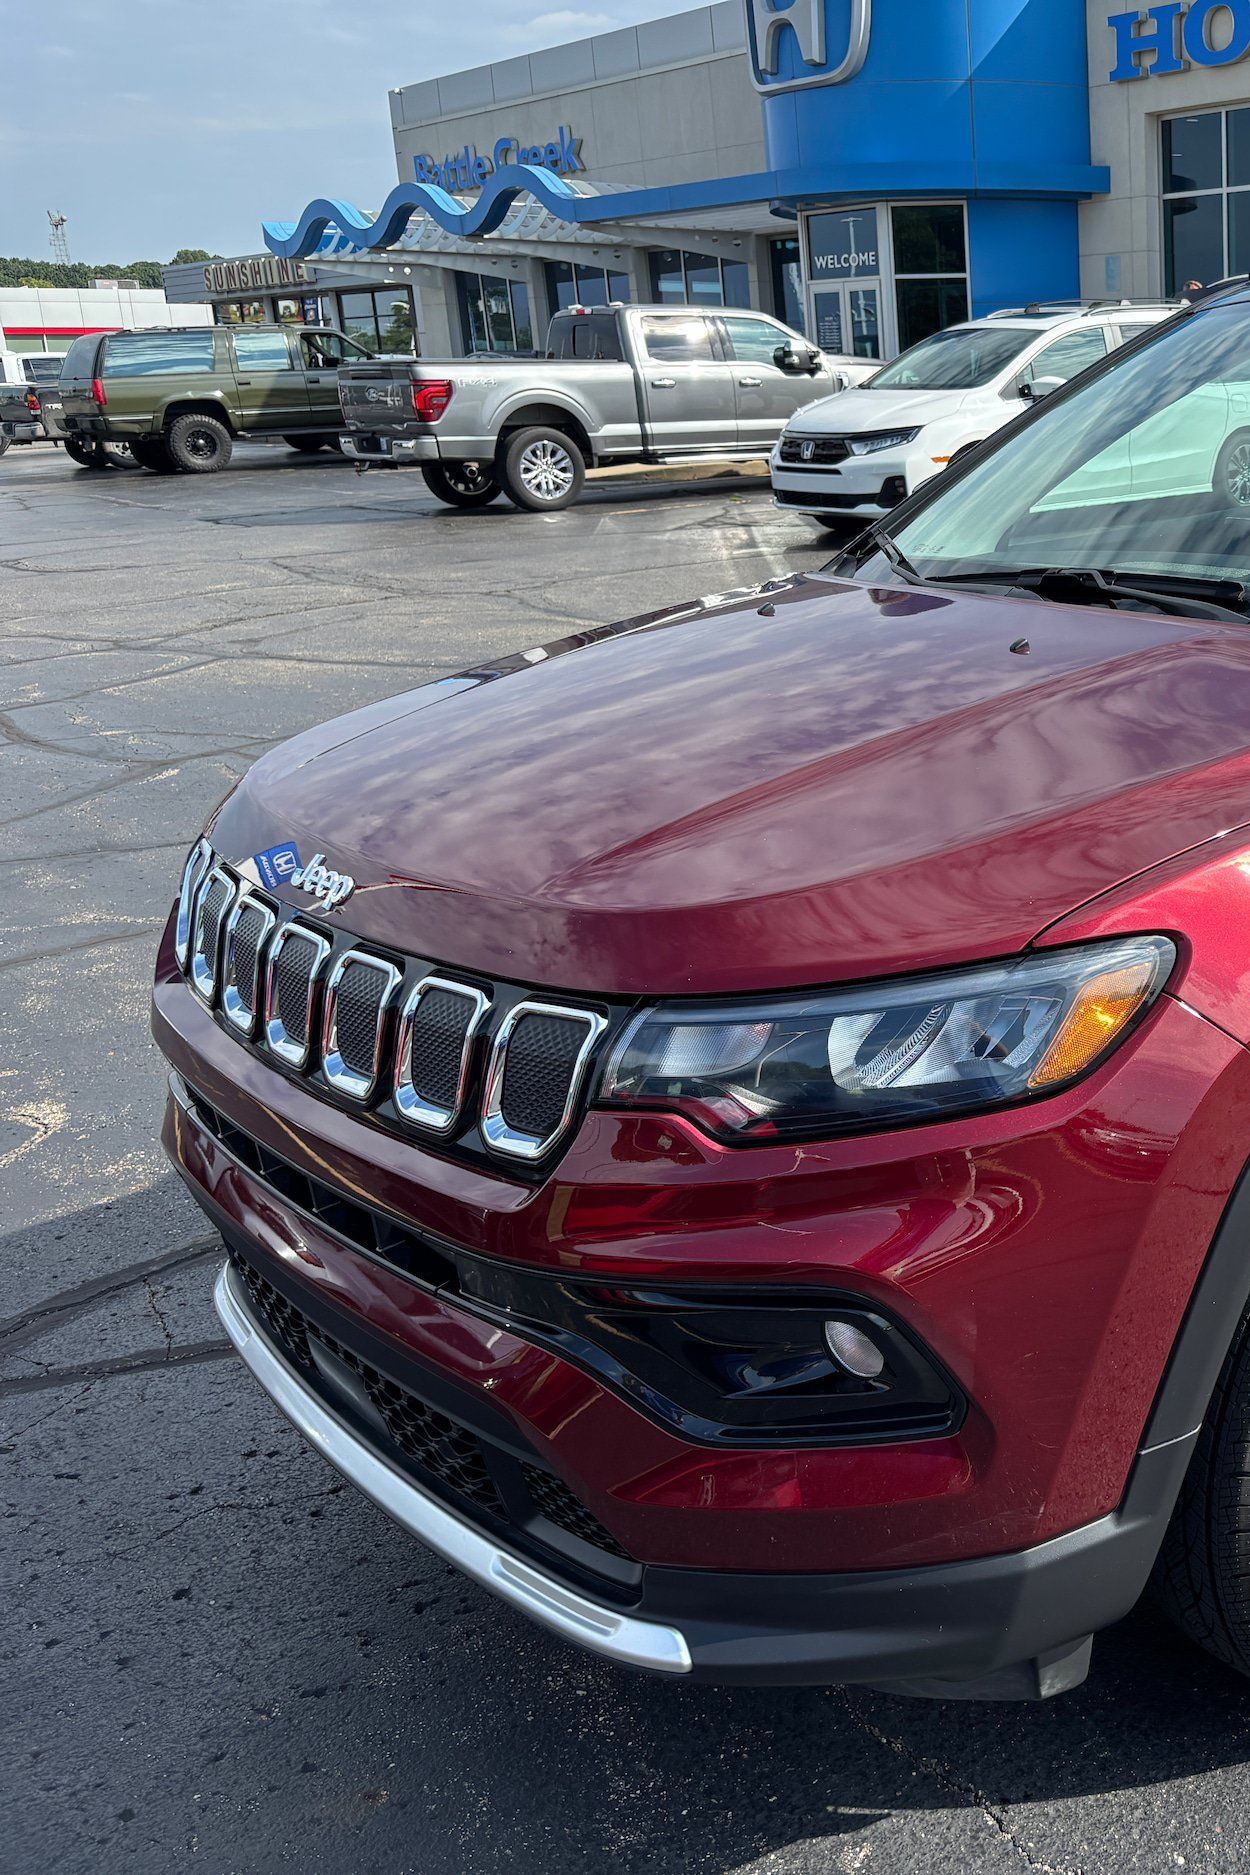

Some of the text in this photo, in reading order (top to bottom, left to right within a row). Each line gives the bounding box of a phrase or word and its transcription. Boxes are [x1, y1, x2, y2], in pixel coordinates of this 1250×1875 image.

[413, 125, 580, 190] Battle Creek
[203, 258, 305, 291] SUNSHINE
[815, 252, 876, 269] WELCOME
[290, 853, 355, 911] Jeep
